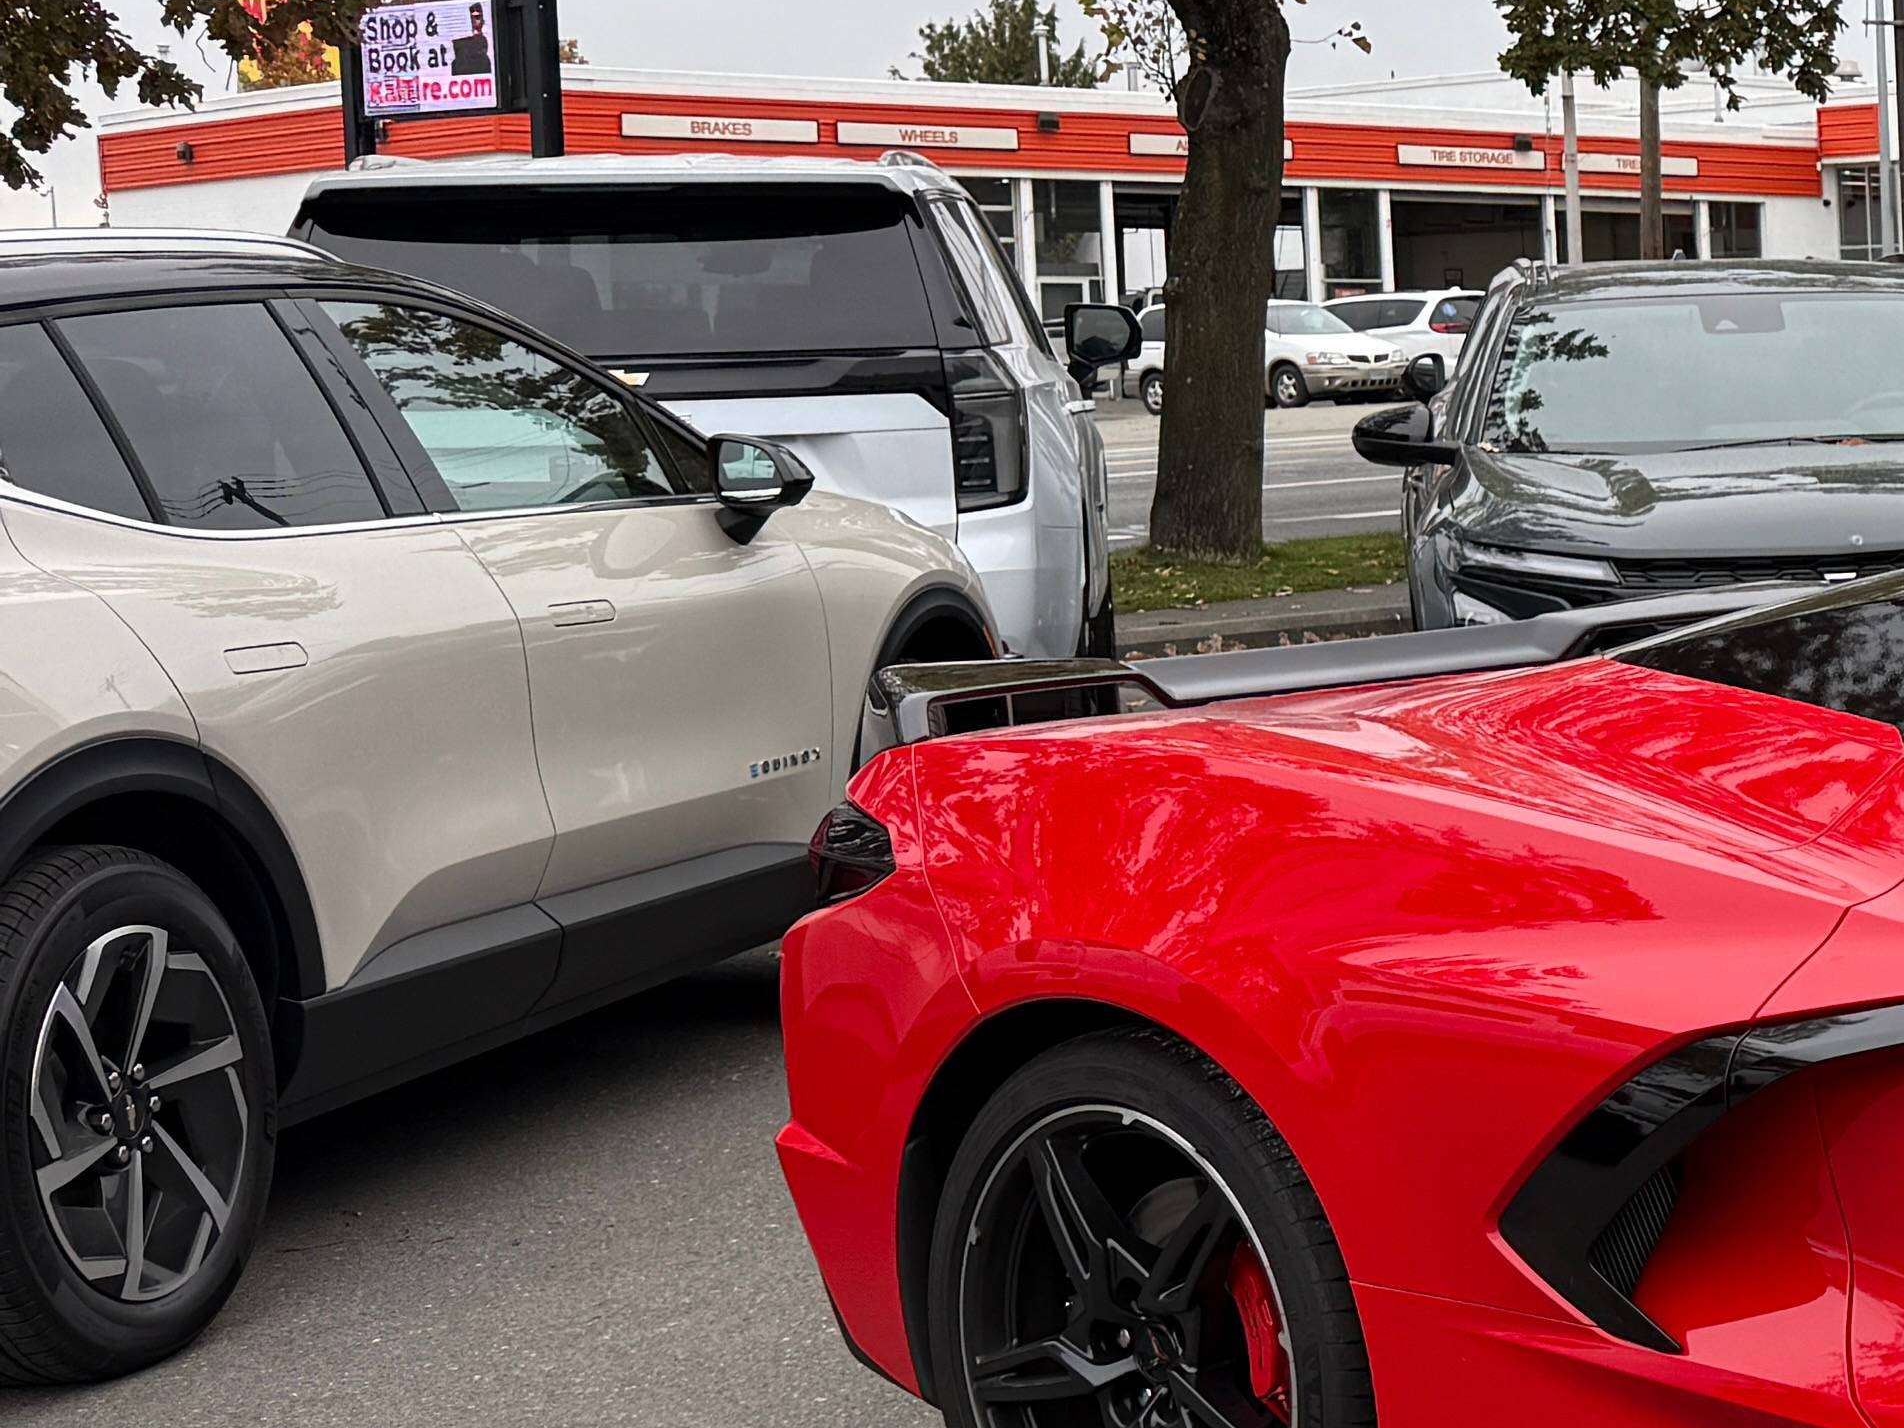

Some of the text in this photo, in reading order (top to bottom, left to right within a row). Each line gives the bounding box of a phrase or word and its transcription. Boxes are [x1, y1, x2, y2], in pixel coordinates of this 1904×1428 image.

[366, 11, 438, 45] Shop &
[369, 44, 448, 73] Book at
[690, 121, 752, 136] BRAKES
[899, 128, 958, 144] WHEELS
[1431, 149, 1513, 165] TIRE STORAGE
[749, 747, 820, 778] EQUINOX
